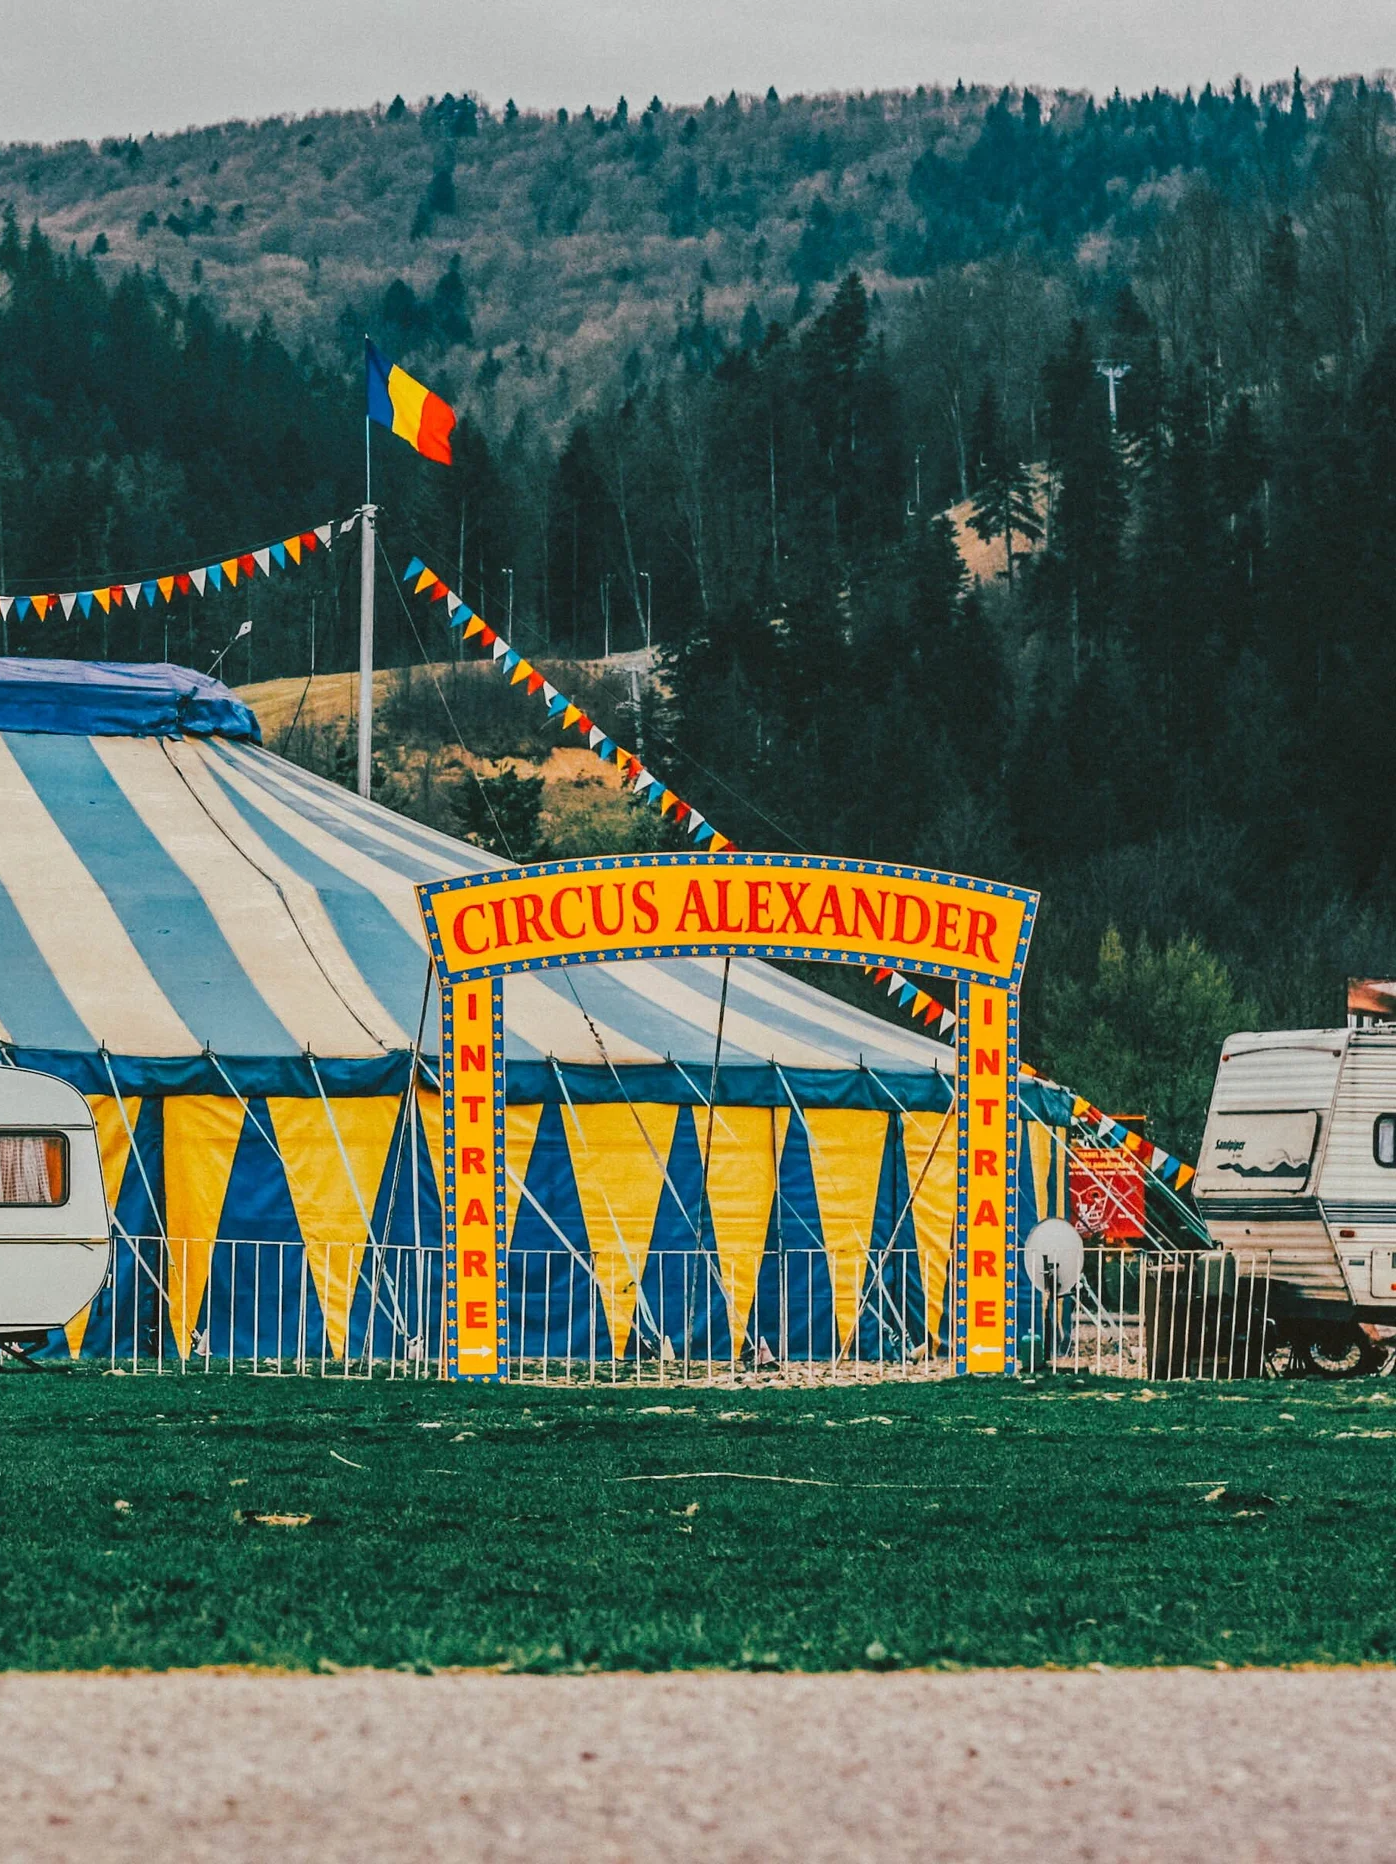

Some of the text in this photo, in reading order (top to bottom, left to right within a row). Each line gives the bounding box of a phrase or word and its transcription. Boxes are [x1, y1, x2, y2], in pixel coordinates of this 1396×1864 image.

[453, 879, 999, 964] CIRCUS ALEXANDER
[460, 993, 489, 1329] INTRARE
[973, 999, 1000, 1327] INTRARE
